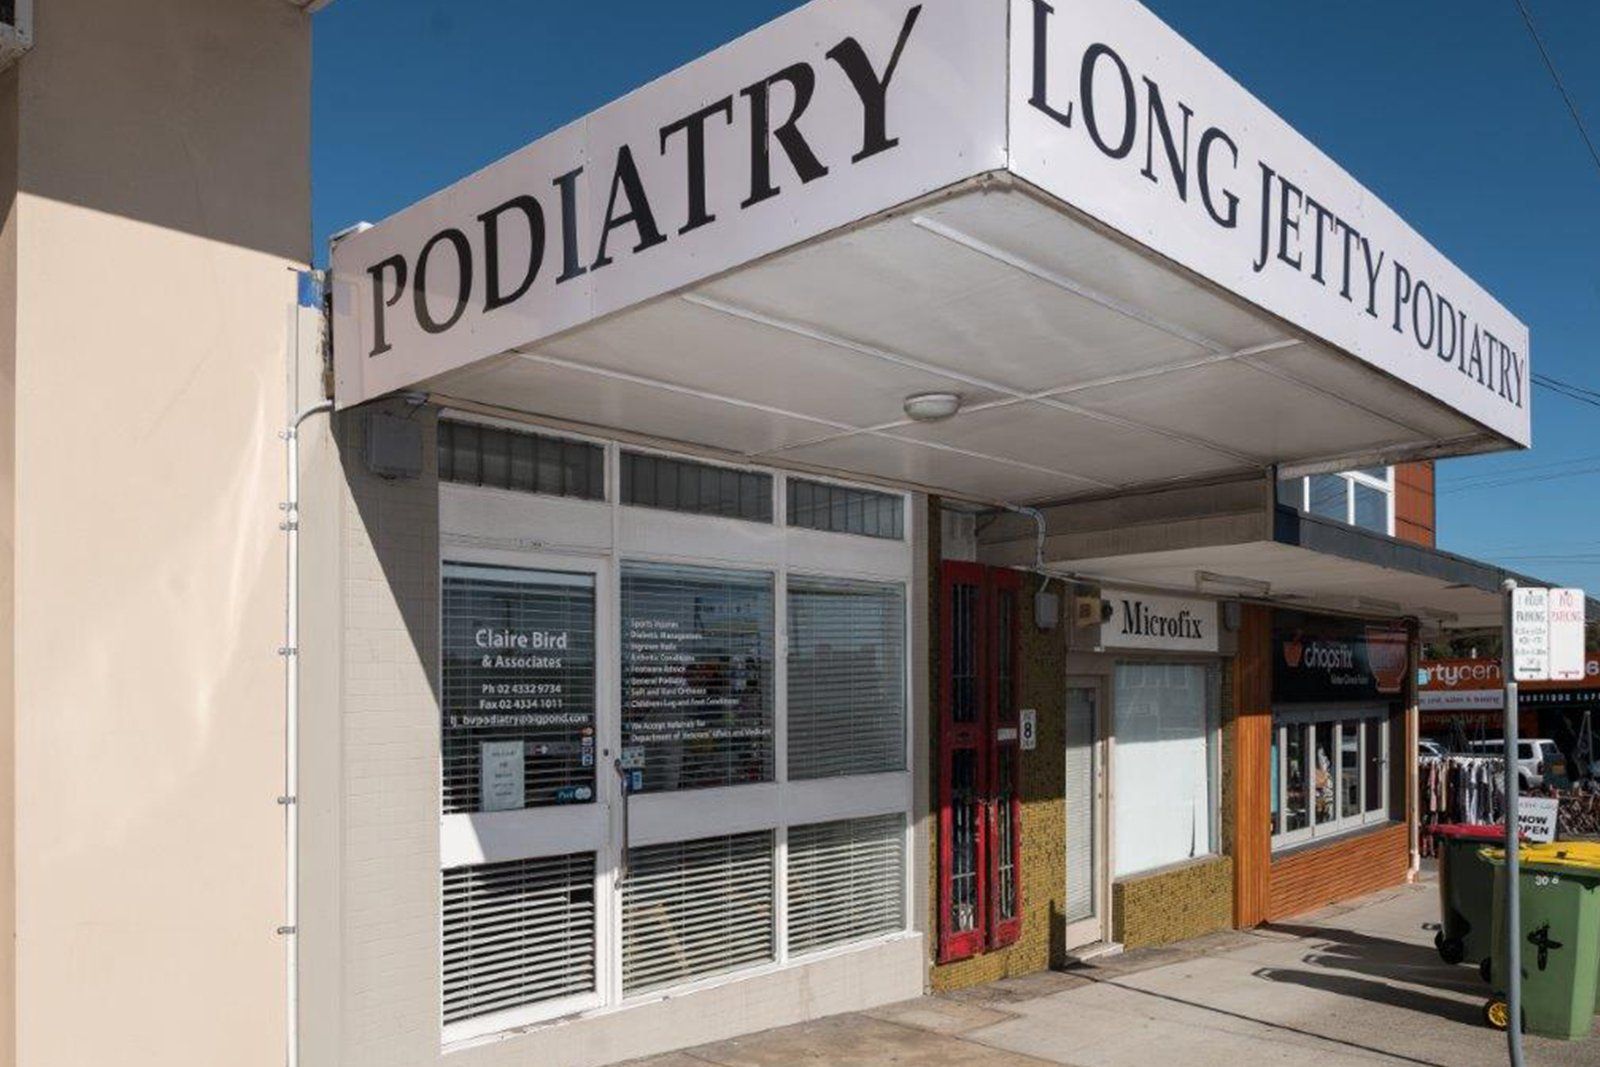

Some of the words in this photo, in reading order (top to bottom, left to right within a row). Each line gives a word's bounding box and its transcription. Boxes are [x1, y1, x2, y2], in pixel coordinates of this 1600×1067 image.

[366, 4, 922, 357] PODIATRY
[1028, 0, 1240, 229] LONG
[1253, 160, 1384, 319] JETTY
[1393, 259, 1524, 409] PODIATRY
[1559, 595, 1573, 606] NO
[1121, 600, 1202, 639] Microfix
[1516, 611, 1545, 622] PARKING
[475, 628, 528, 648] Claire
[532, 631, 567, 649] Bird
[482, 654, 492, 668] &
[494, 655, 562, 669] Associates
[1426, 663, 1500, 685] rtycen
[482, 683, 495, 694] Ph
[497, 683, 510, 693] 02
[511, 684, 536, 693] 4332
[479, 699, 498, 710] Fax
[499, 700, 510, 709] 02
[1023, 721, 1033, 738] 8
[1518, 815, 1548, 825] NOW
[1534, 875, 1550, 886] 30
